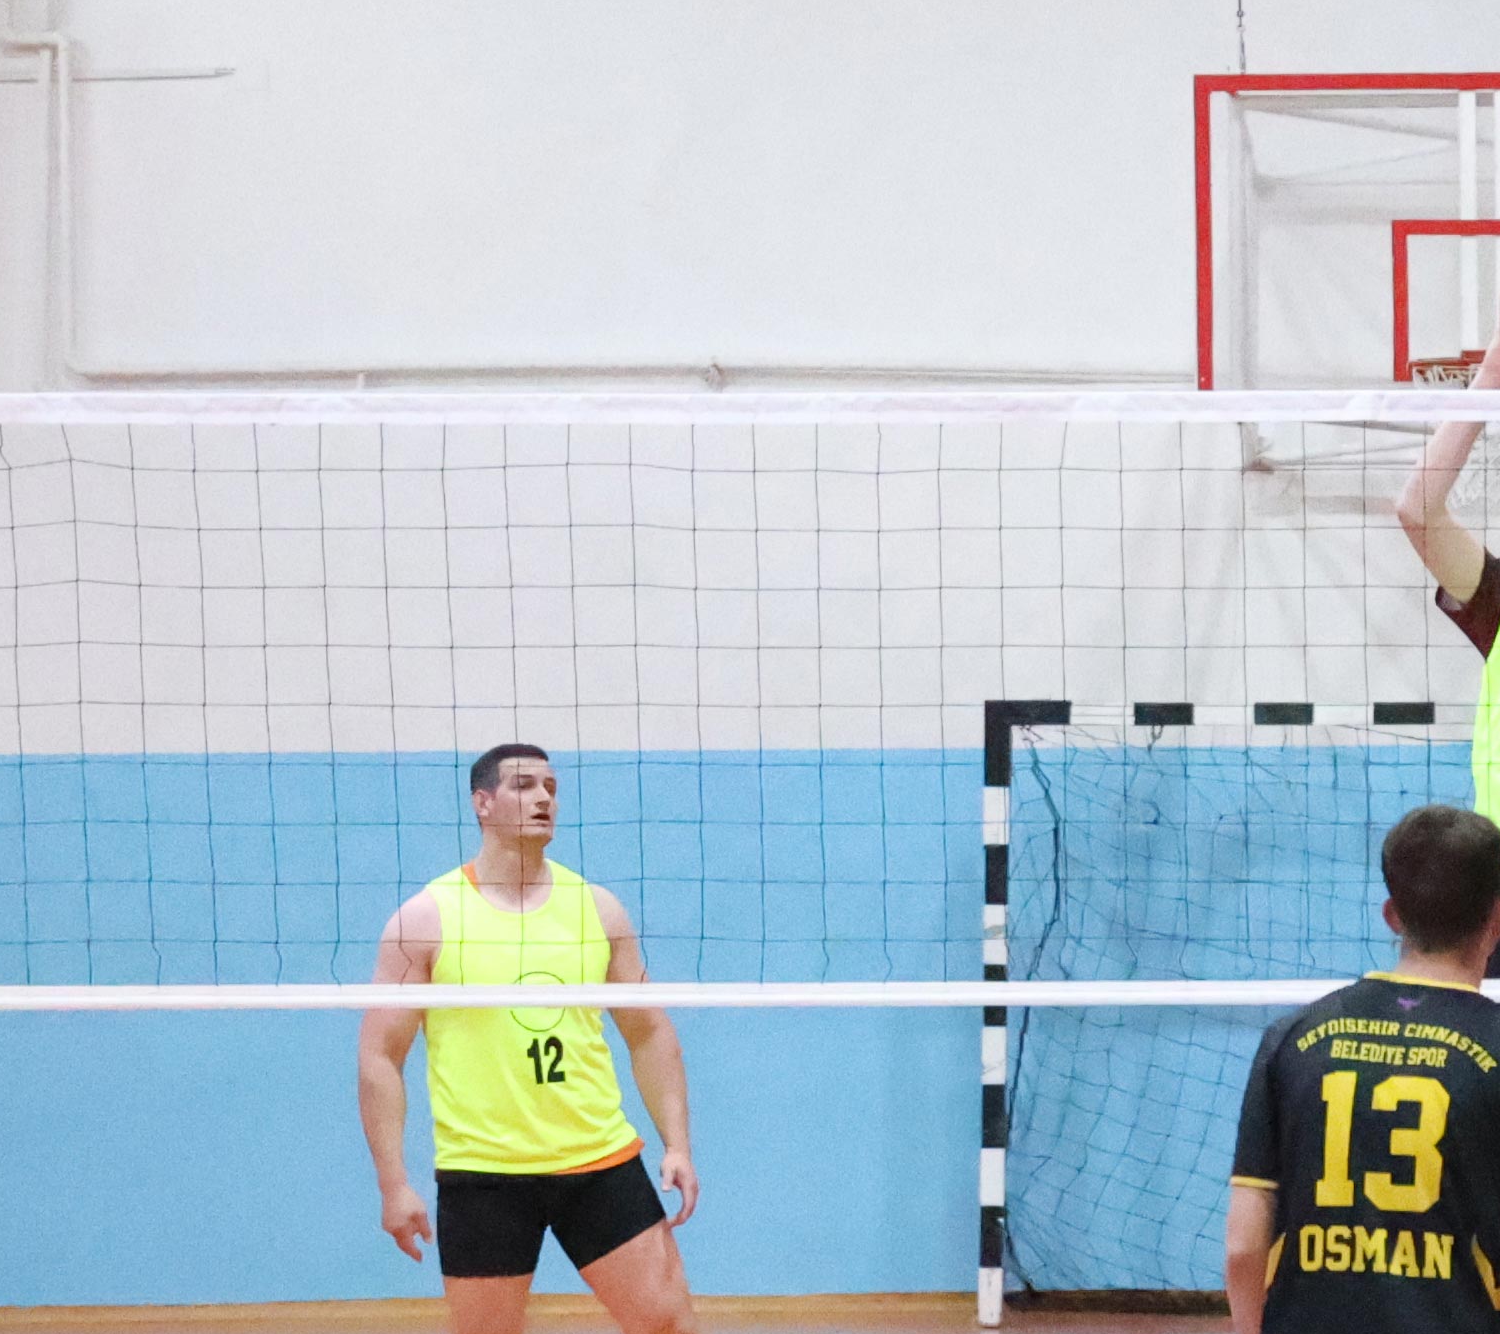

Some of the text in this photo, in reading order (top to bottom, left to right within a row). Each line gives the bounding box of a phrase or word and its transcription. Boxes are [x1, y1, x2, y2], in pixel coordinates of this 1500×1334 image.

[526, 1036, 566, 1083] 12
[1406, 1046, 1449, 1068] SPOR
[1314, 1069, 1451, 1213] 13
[1299, 1224, 1455, 1280] OSMAN
